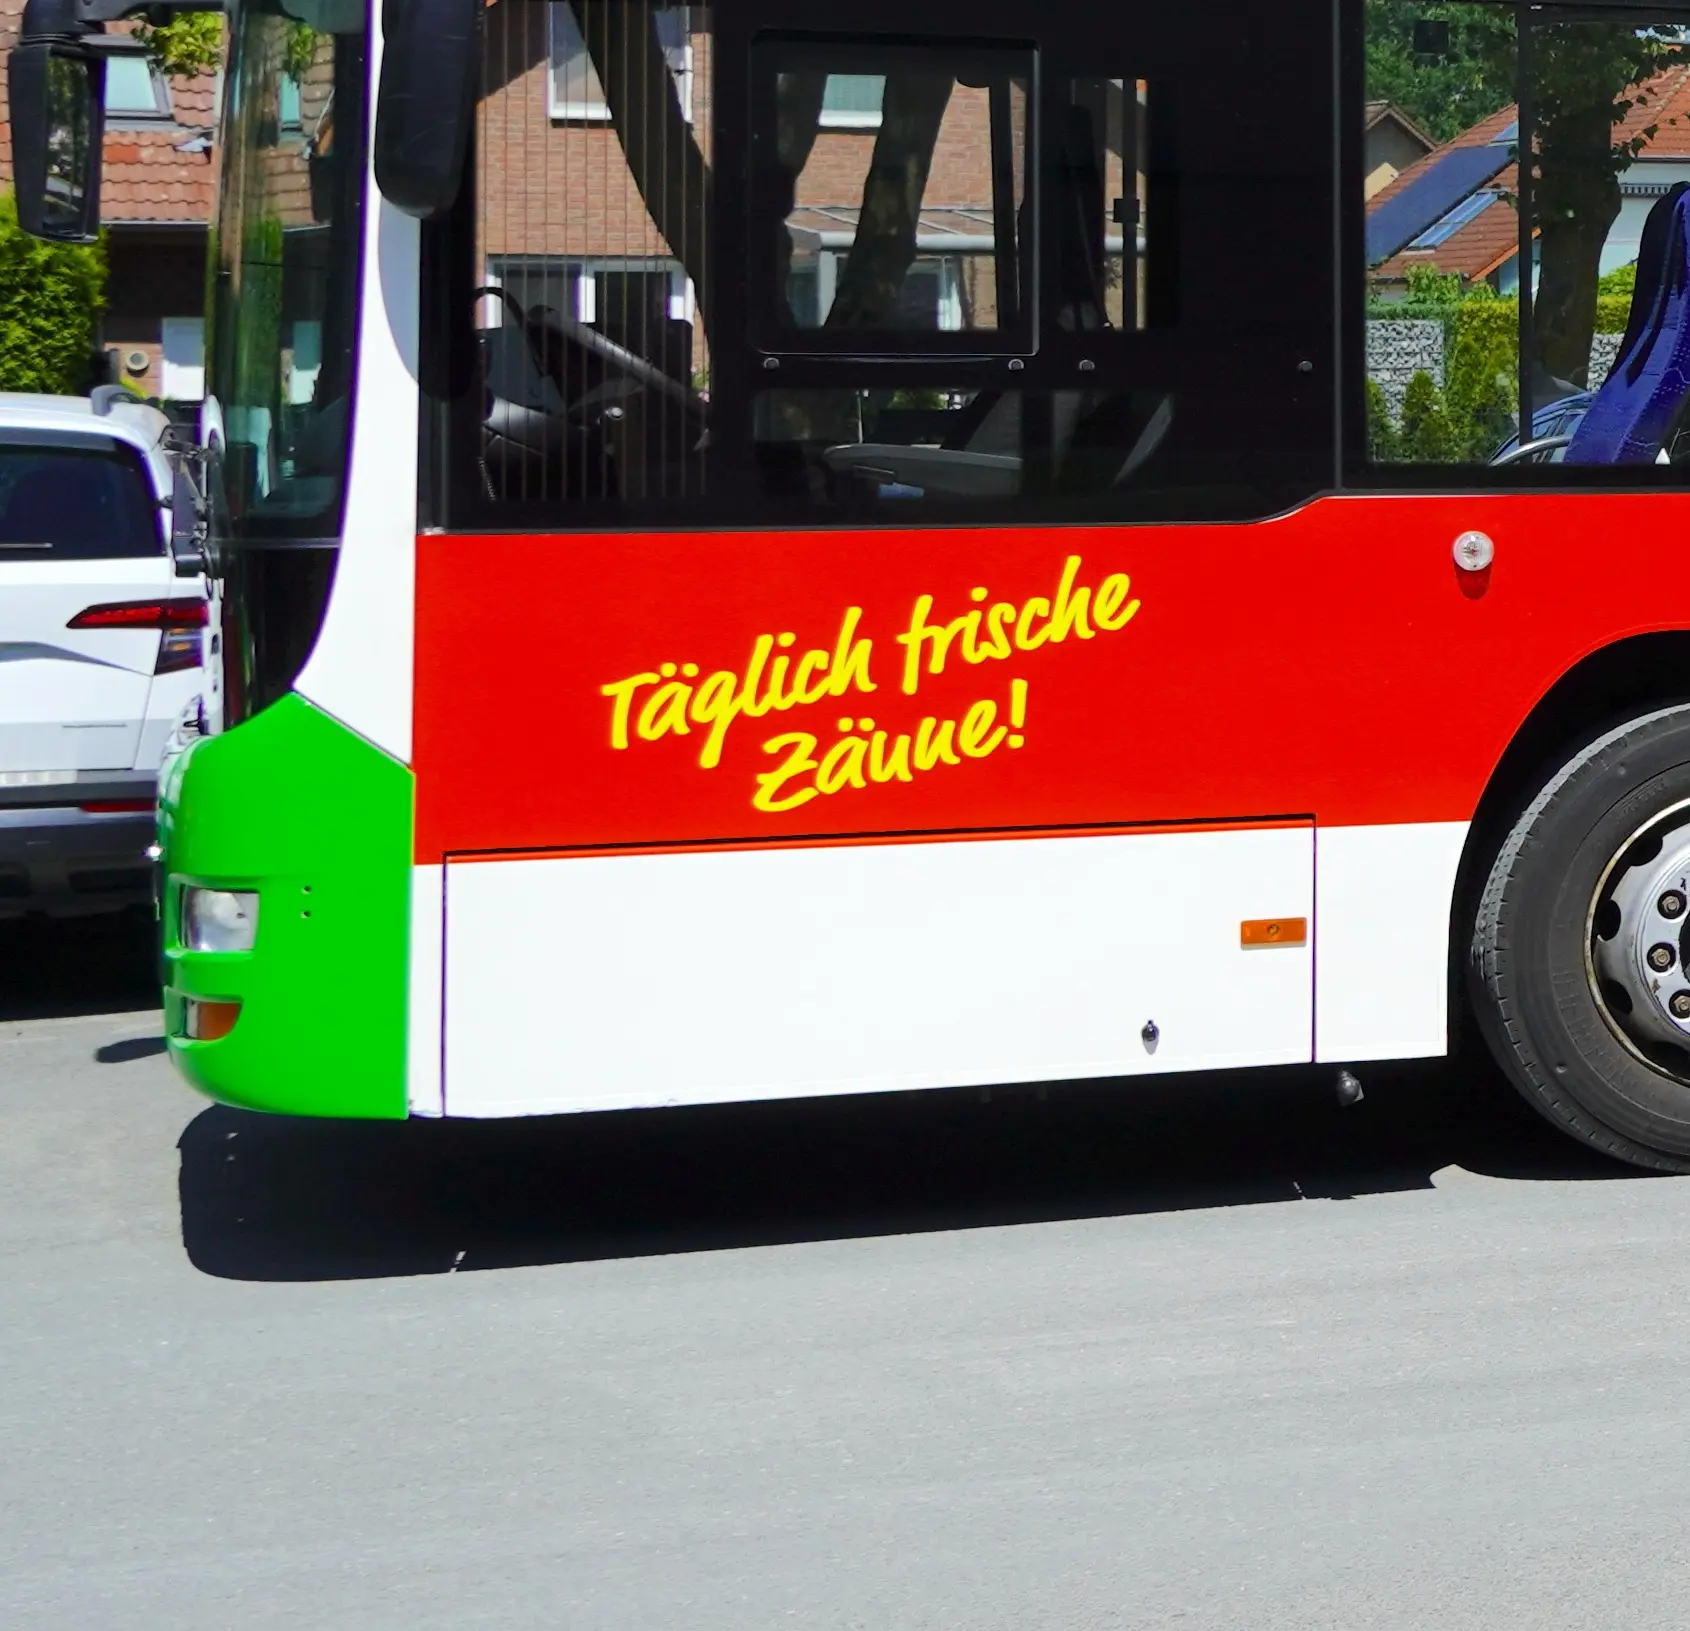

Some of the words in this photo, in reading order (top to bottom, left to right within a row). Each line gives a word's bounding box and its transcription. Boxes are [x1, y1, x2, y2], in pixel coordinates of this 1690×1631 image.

[600, 606, 878, 769] Täglich
[895, 554, 1141, 696] frische
[751, 678, 1029, 813] Zäune!
